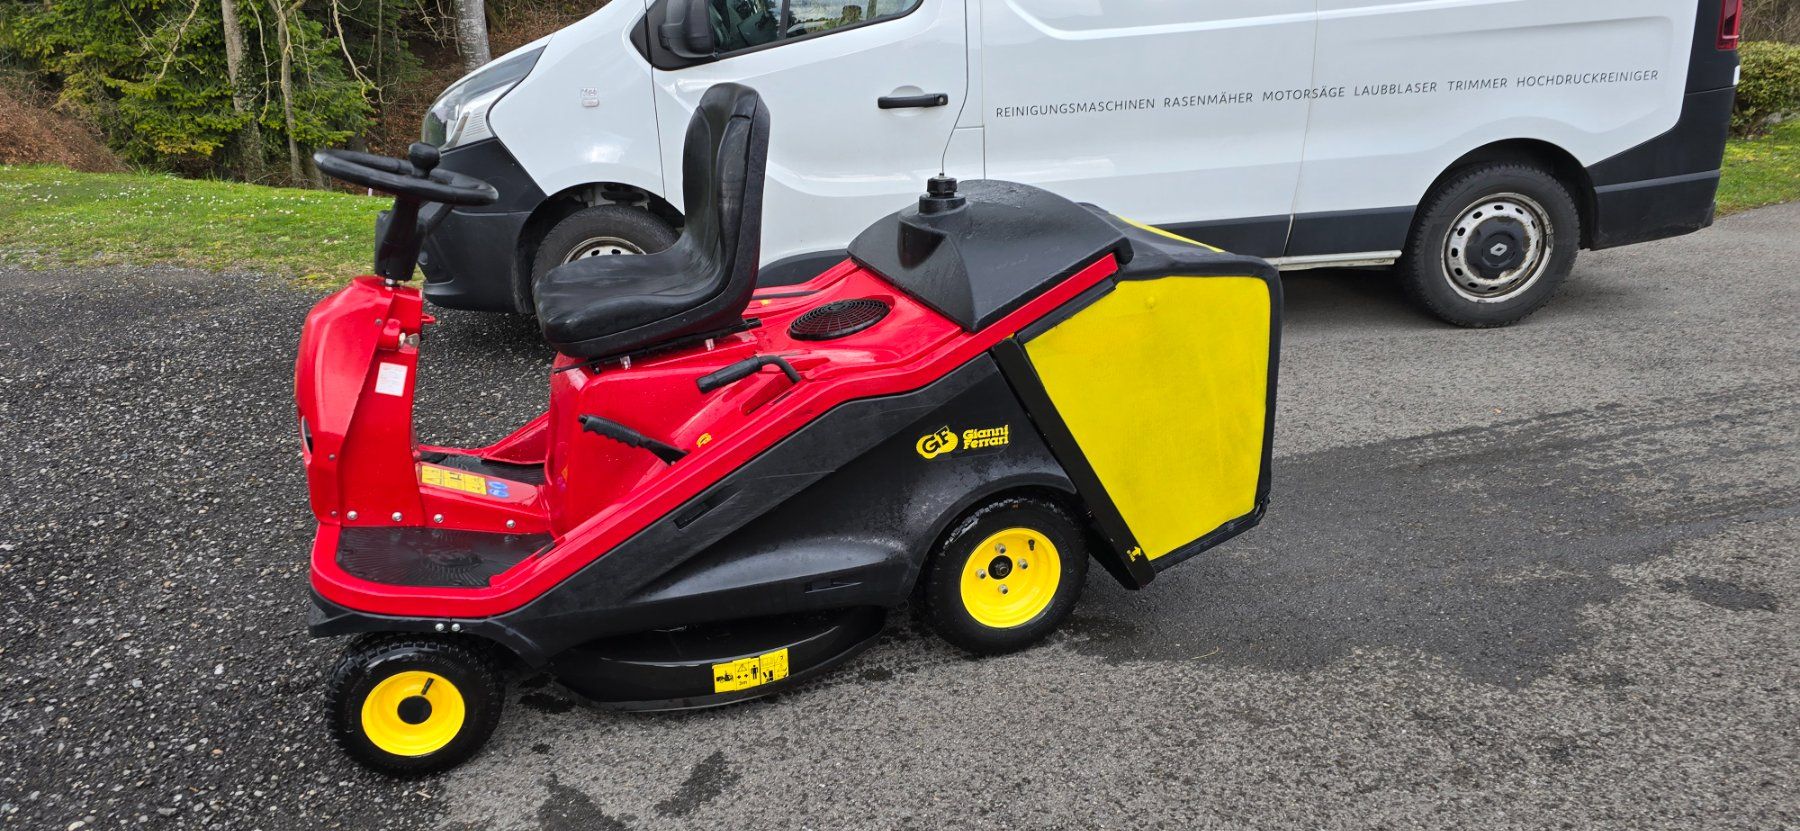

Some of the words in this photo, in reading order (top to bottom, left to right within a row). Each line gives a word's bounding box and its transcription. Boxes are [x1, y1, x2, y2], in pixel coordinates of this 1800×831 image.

[995, 98, 1156, 118] REINIGUNGSMASCHINEN
[1163, 91, 1254, 108] RASENMÄHER
[1261, 86, 1346, 102] MOTORSÄGE
[1353, 81, 1438, 97] LAUBBLASER
[1447, 77, 1508, 92] TRIMMER
[1515, 69, 1659, 88] HOCHDRUCKREINIGER
[919, 425, 952, 455] GF
[962, 424, 1009, 440] Gianni
[962, 435, 1010, 450] Ferrari
